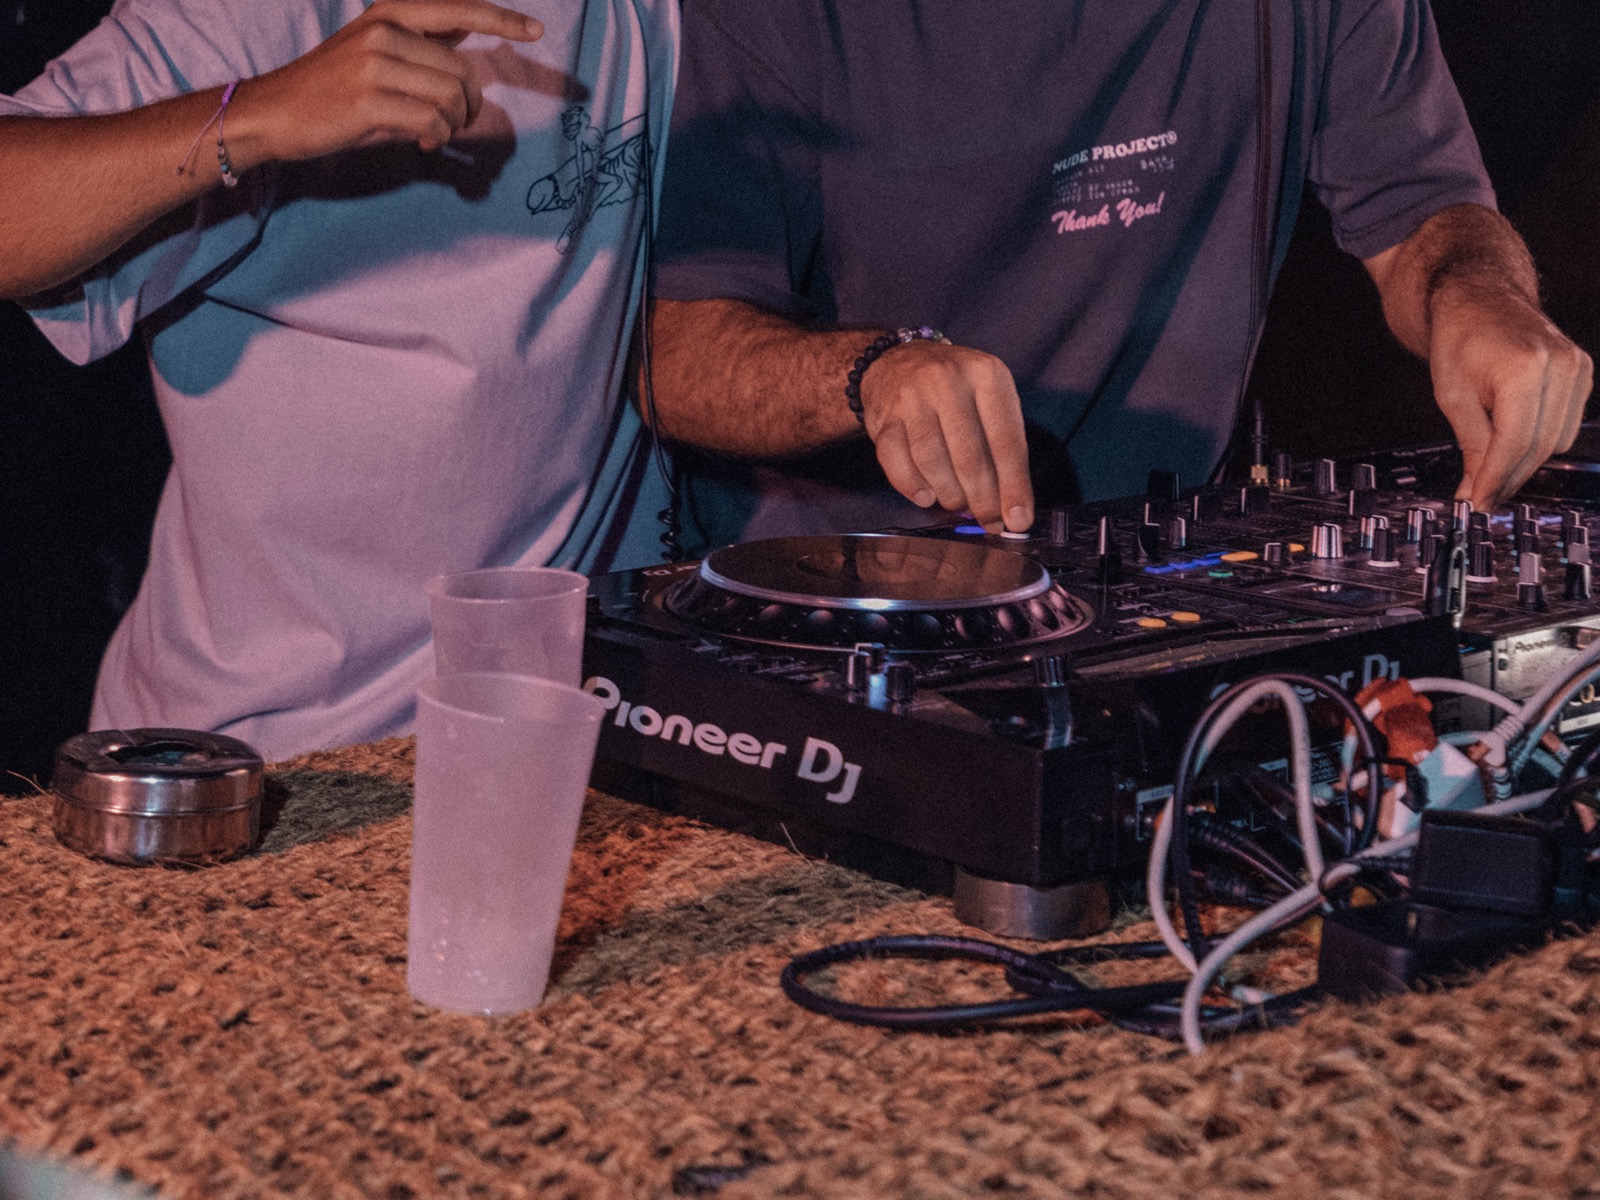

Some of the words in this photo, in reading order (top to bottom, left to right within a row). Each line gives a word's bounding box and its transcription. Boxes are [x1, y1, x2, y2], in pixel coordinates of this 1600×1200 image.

[1052, 149, 1089, 177] NUDE
[1051, 203, 1111, 235] Thank
[1115, 191, 1166, 228] You!
[582, 675, 788, 769] Pioneer
[796, 736, 863, 804] DJ
